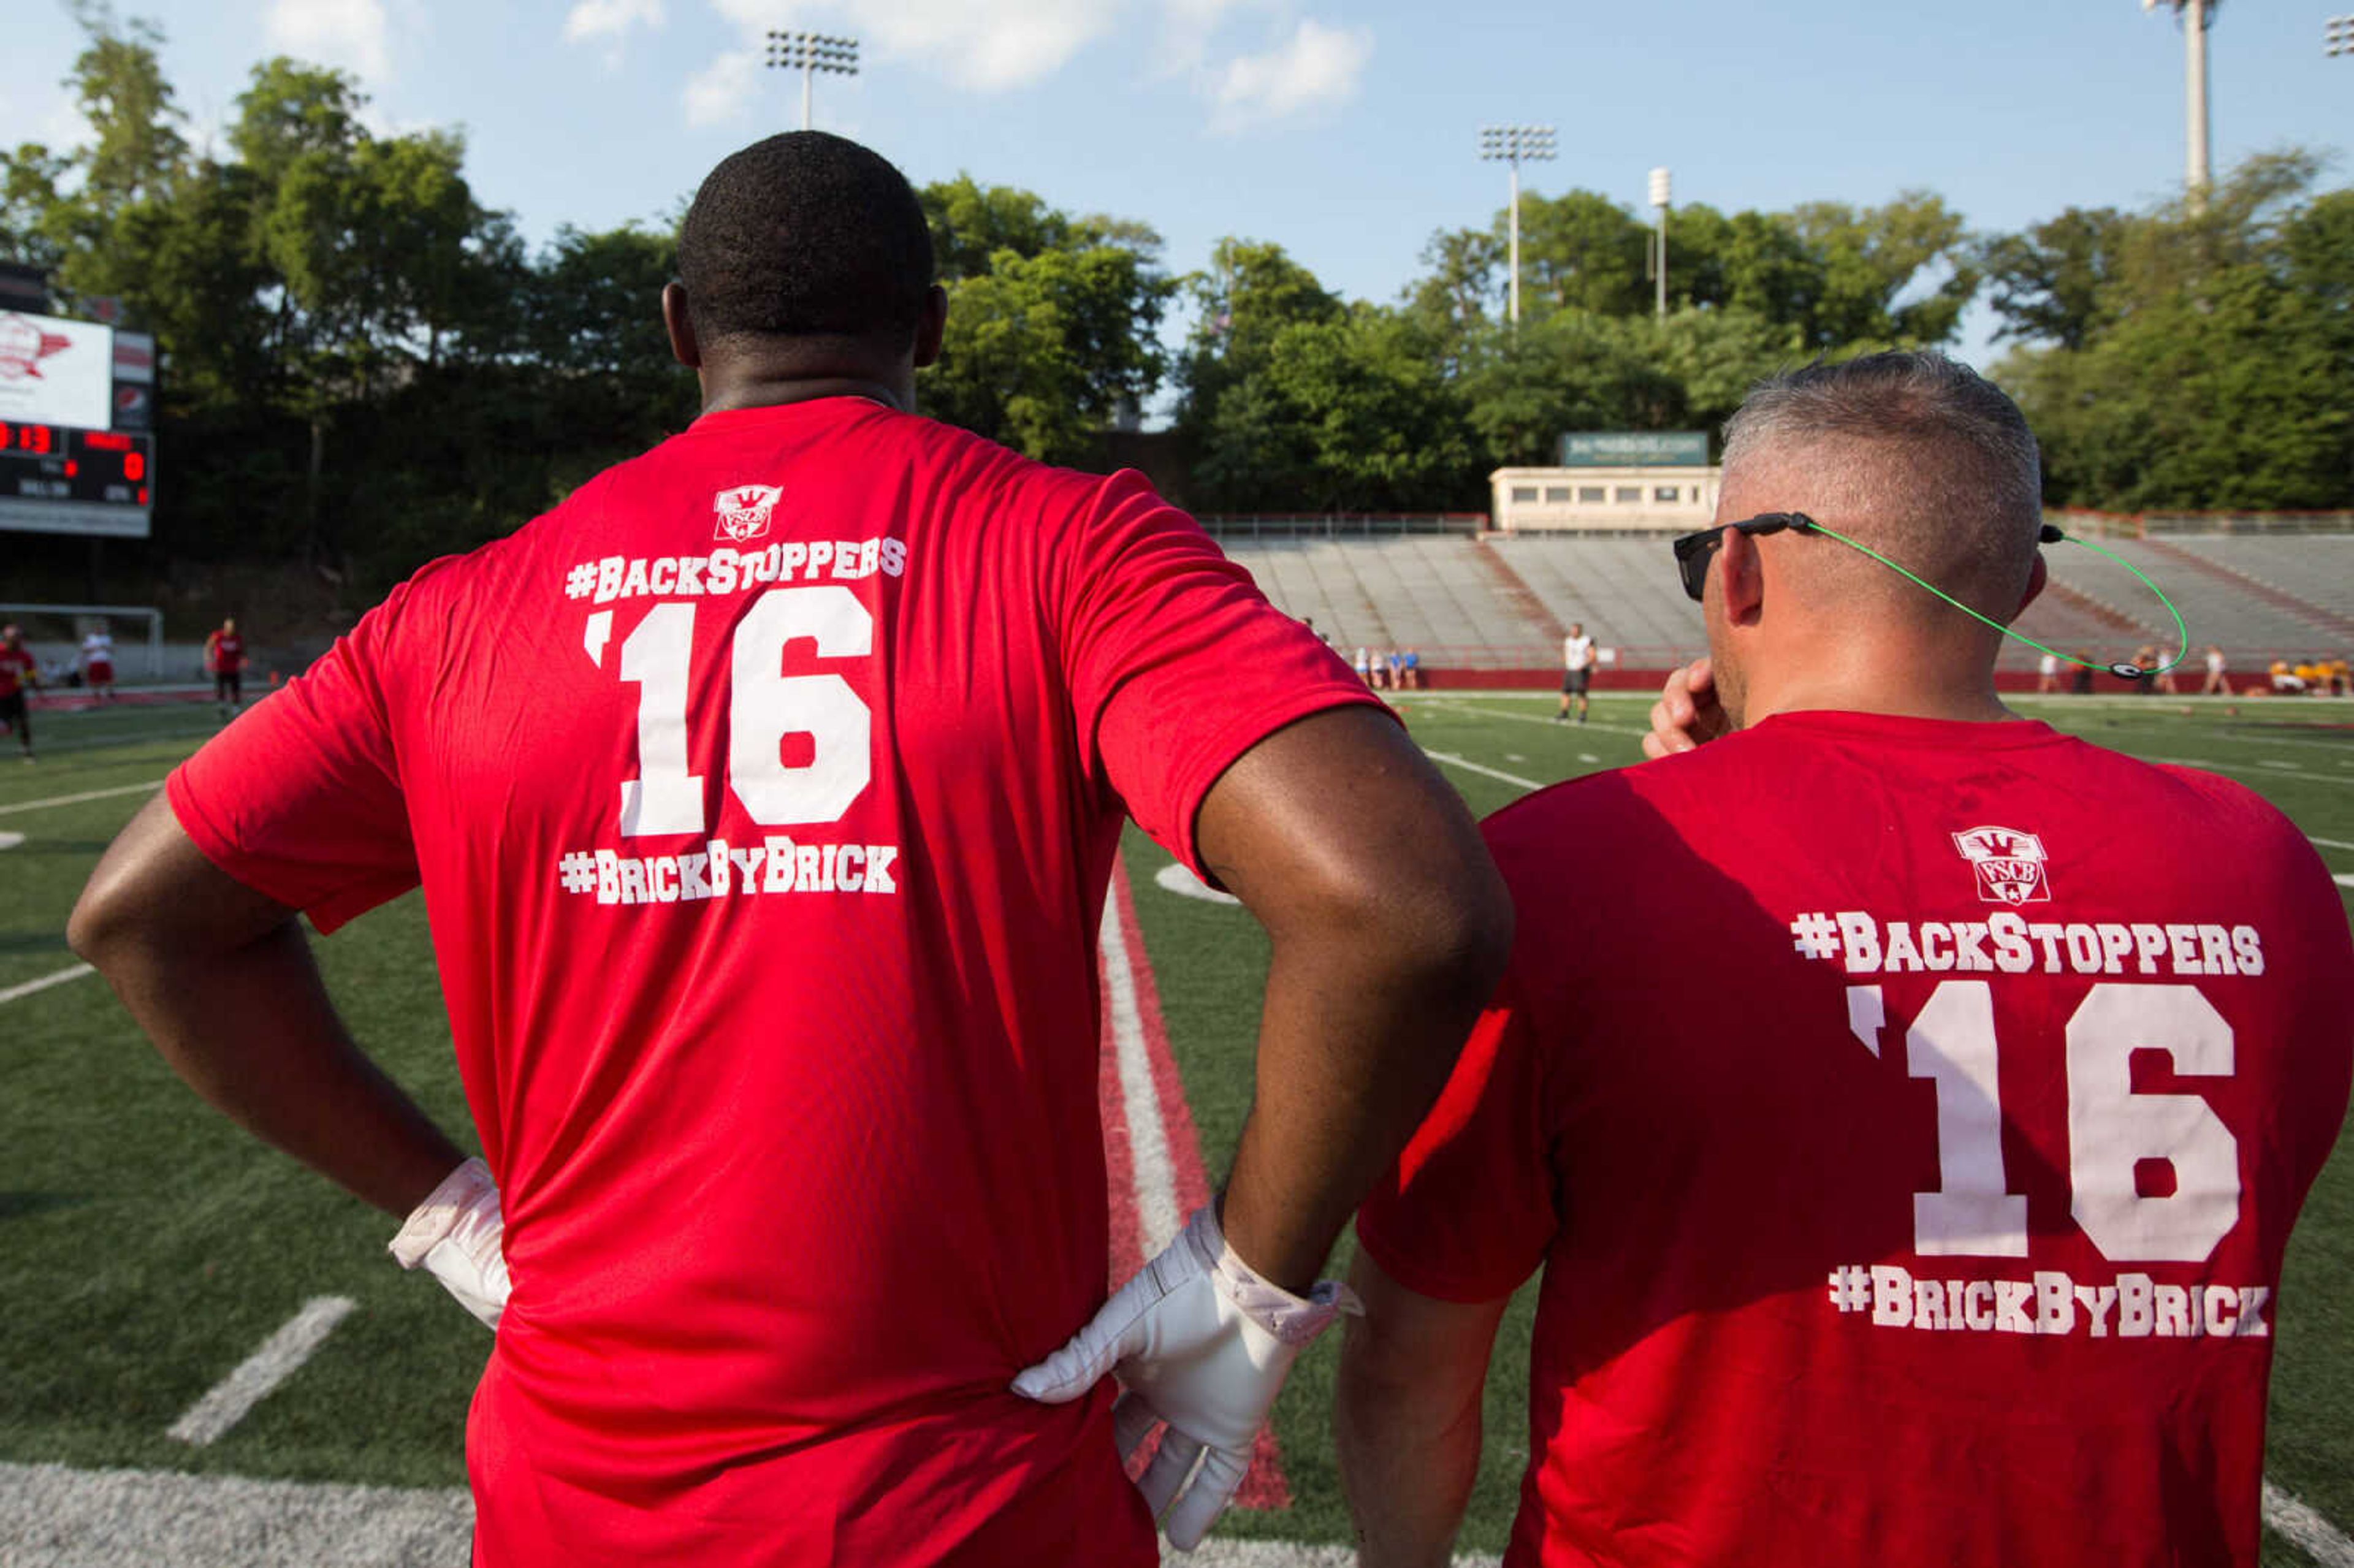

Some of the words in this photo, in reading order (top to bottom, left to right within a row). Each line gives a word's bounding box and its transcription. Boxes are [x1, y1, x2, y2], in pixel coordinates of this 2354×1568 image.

[584, 585, 875, 836] '16
[1981, 859, 2036, 883] FSCB
[1846, 980, 2241, 1262] '16
